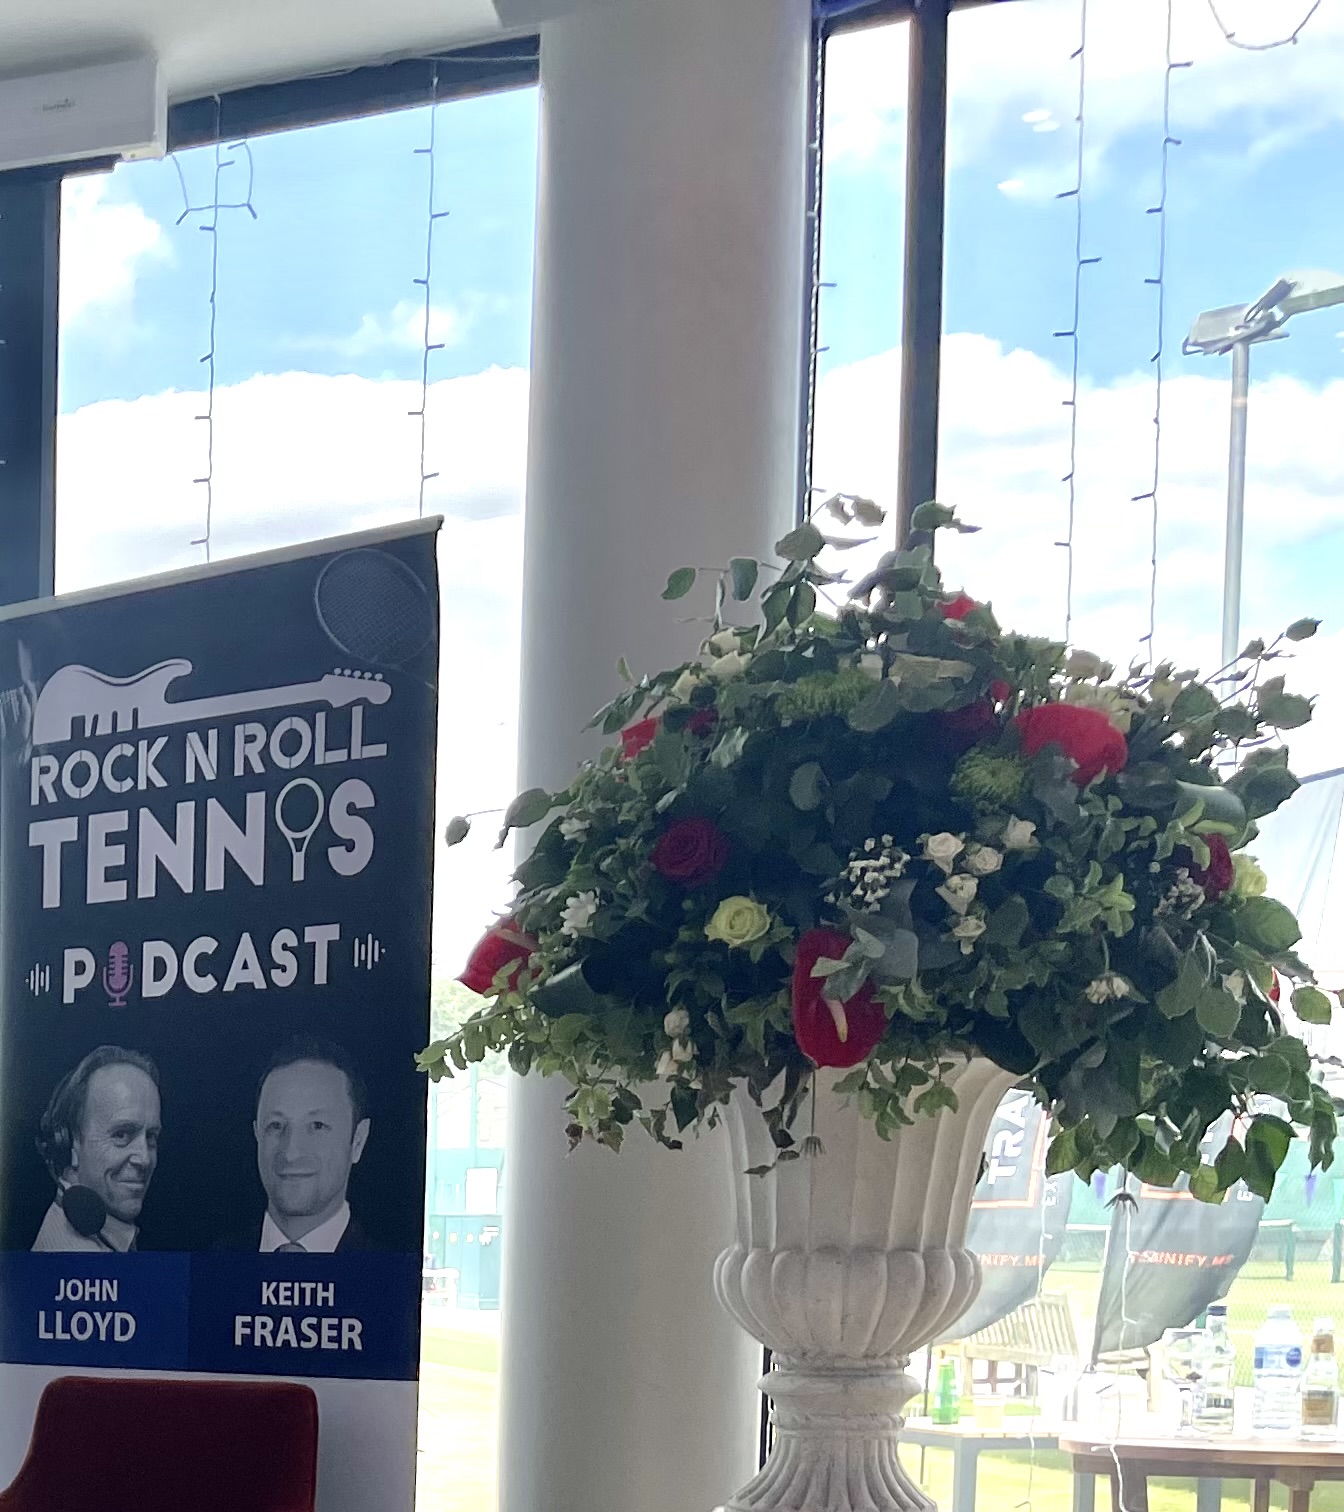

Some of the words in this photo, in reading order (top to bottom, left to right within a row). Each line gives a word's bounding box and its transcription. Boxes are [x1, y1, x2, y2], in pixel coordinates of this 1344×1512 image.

[31, 735, 168, 806] ROCK
[186, 729, 218, 782] N
[234, 705, 388, 776] ROLL
[55, 1278, 118, 1302] JOHN
[261, 1281, 334, 1306] KEITH
[38, 1310, 136, 1342] LLOYD
[235, 1316, 363, 1351] FRASER
